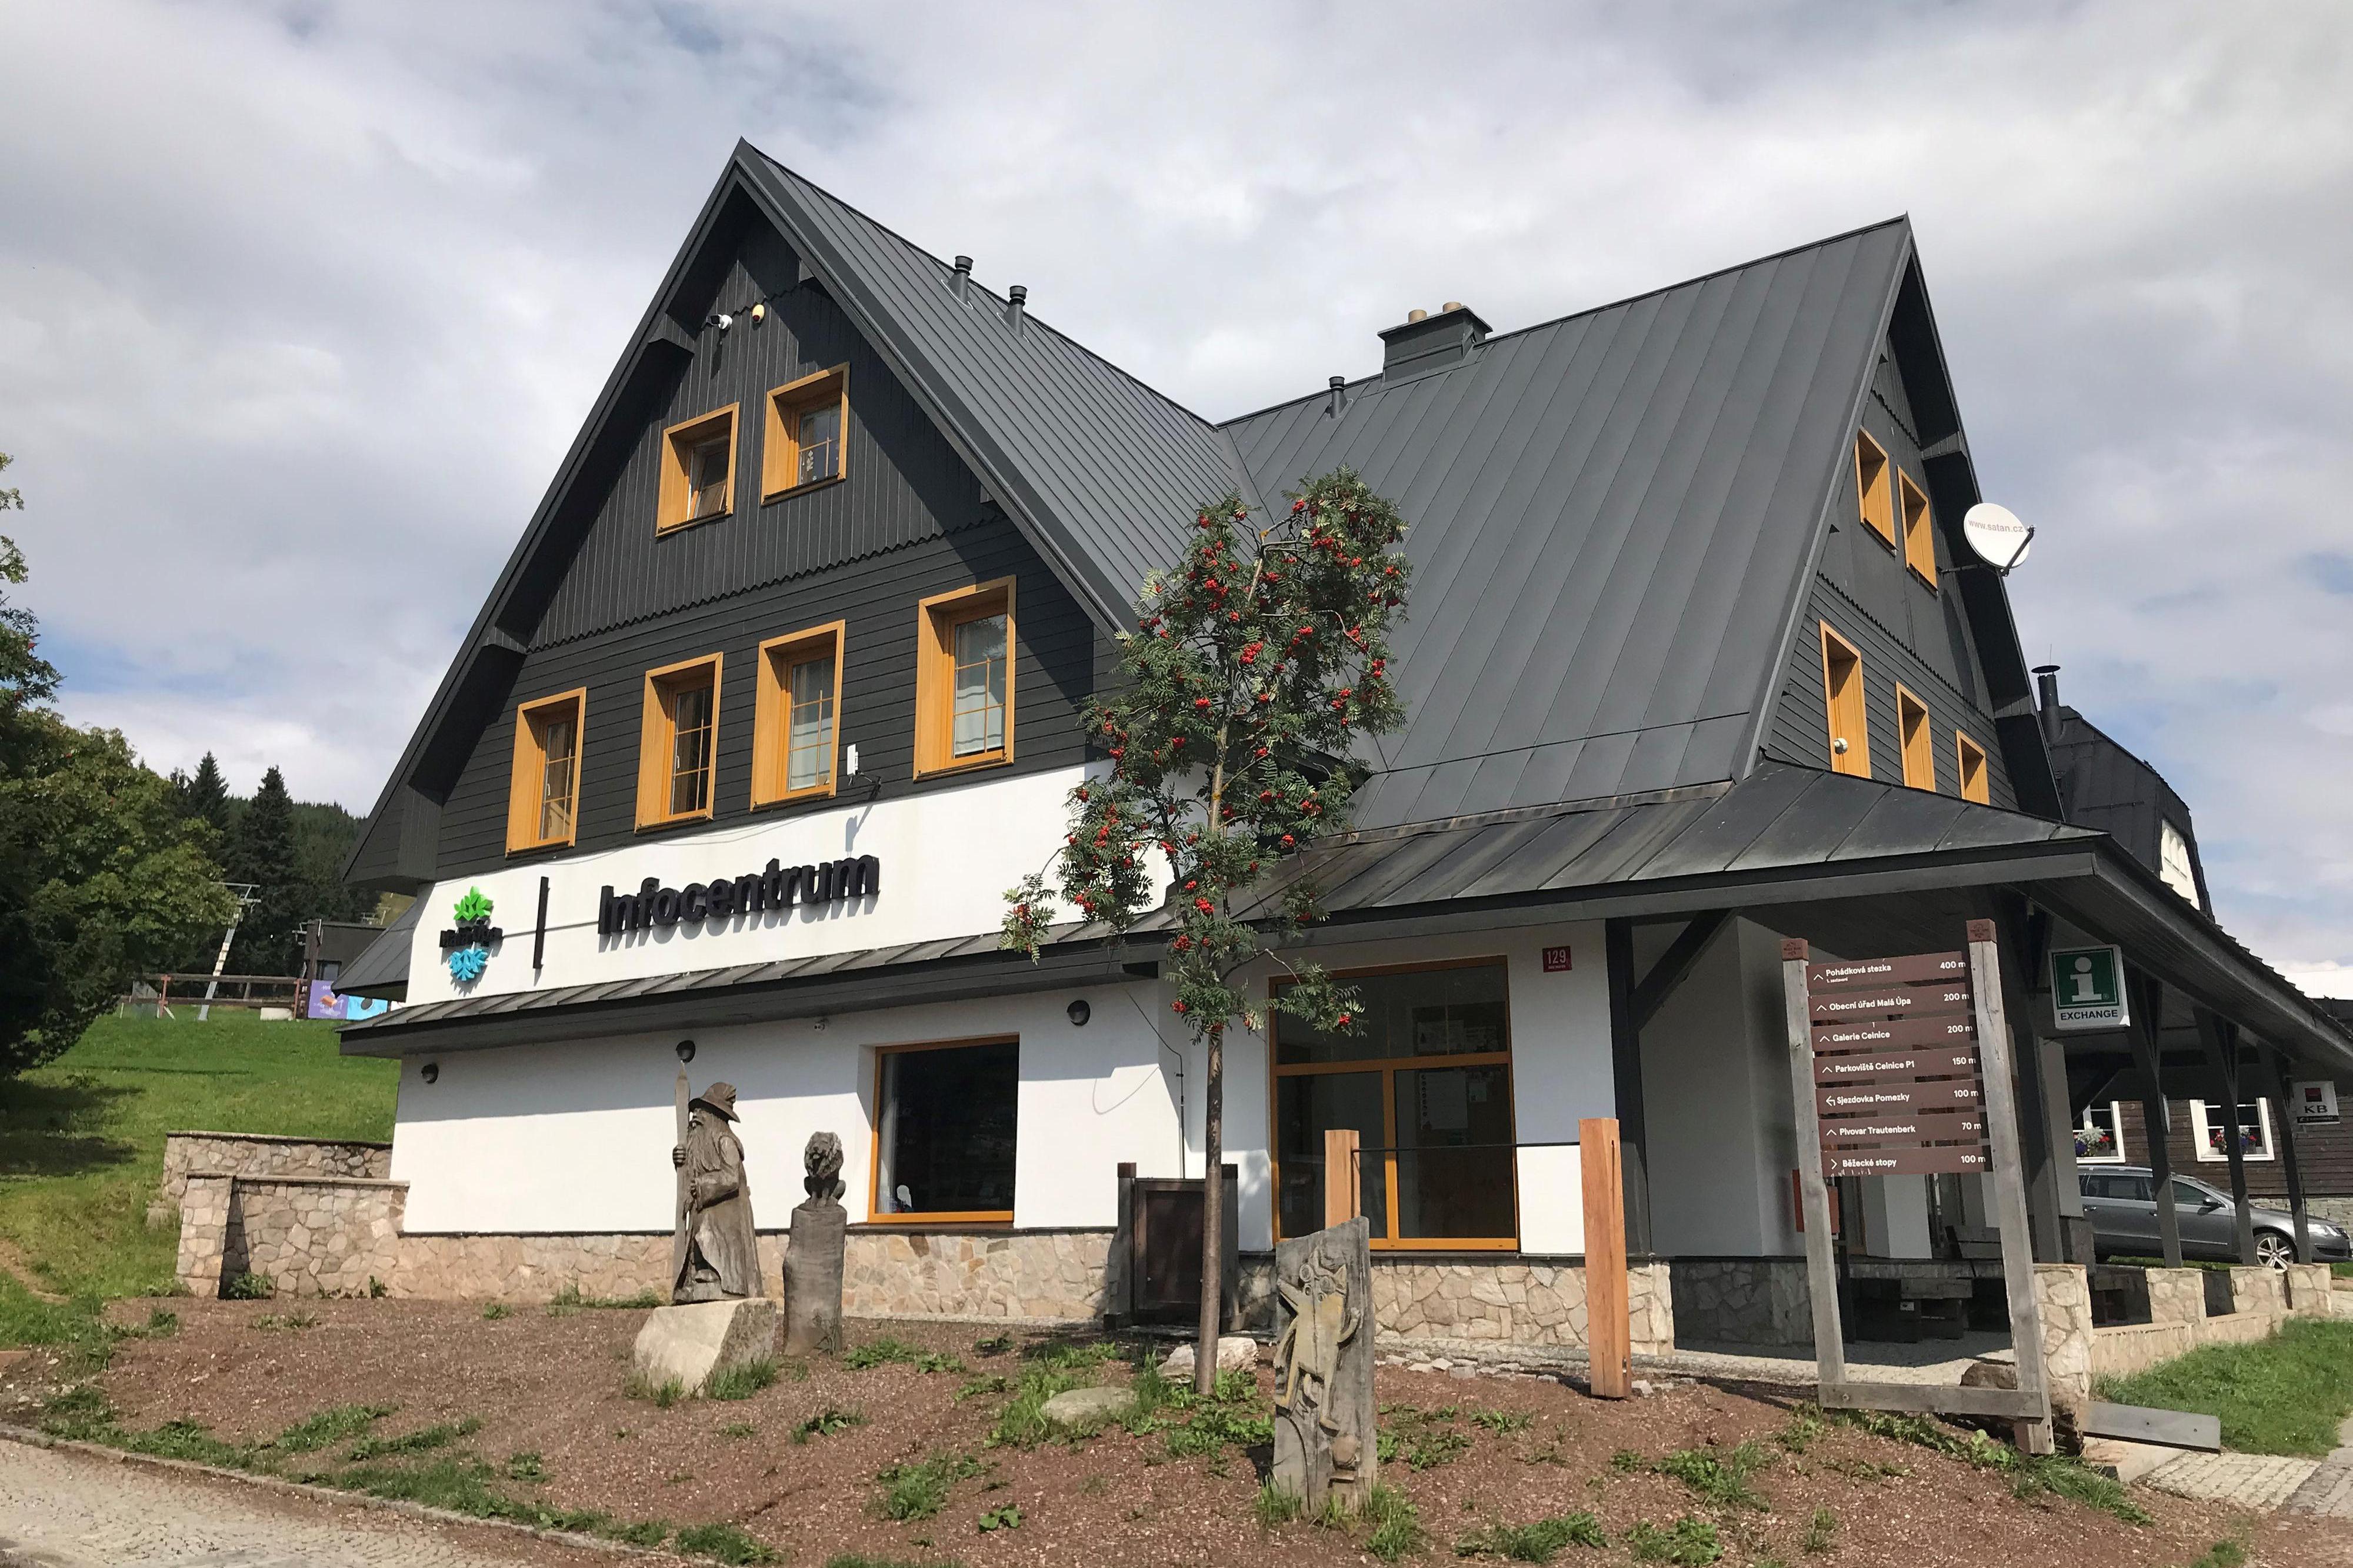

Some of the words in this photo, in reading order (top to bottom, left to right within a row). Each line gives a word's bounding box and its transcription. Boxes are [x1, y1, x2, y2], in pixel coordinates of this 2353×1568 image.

[1968, 520, 2023, 532] www.satan.cz
[598, 855, 880, 935] Infocentrum
[1547, 949, 1566, 964] 129
[1825, 966, 1866, 976] Pohádková
[1867, 964, 1892, 973] stezka
[1940, 961, 1957, 969] 400
[1944, 993, 1960, 1001] 200
[1829, 1001, 1857, 1010] Obecní
[1858, 1000, 1875, 1009] úřad
[1877, 999, 1895, 1007] Malá
[1896, 996, 1911, 1006] Úpa
[2060, 1009, 2118, 1020] EXCHANGE
[1947, 1025, 1963, 1033] 200
[1832, 1032, 1860, 1042] Galerie
[1861, 1030, 1891, 1040] Celnice
[1835, 1062, 1874, 1073] Parkoviště
[1875, 1061, 1904, 1070] Celnice
[1905, 1060, 1915, 1069] P1
[1952, 1057, 1967, 1065] 150
[1954, 1089, 1969, 1097] 100
[1837, 1095, 1874, 1106] Sjezdovka
[1875, 1093, 1910, 1103] Pomezky
[2304, 1105, 2328, 1113] KB
[1839, 1127, 1867, 1136] Pivovar
[1867, 1125, 1916, 1135] Trautenberk
[1842, 1159, 1874, 1167] Běžecké
[1875, 1159, 1897, 1168] stopy
[1961, 1155, 1976, 1163] 100
